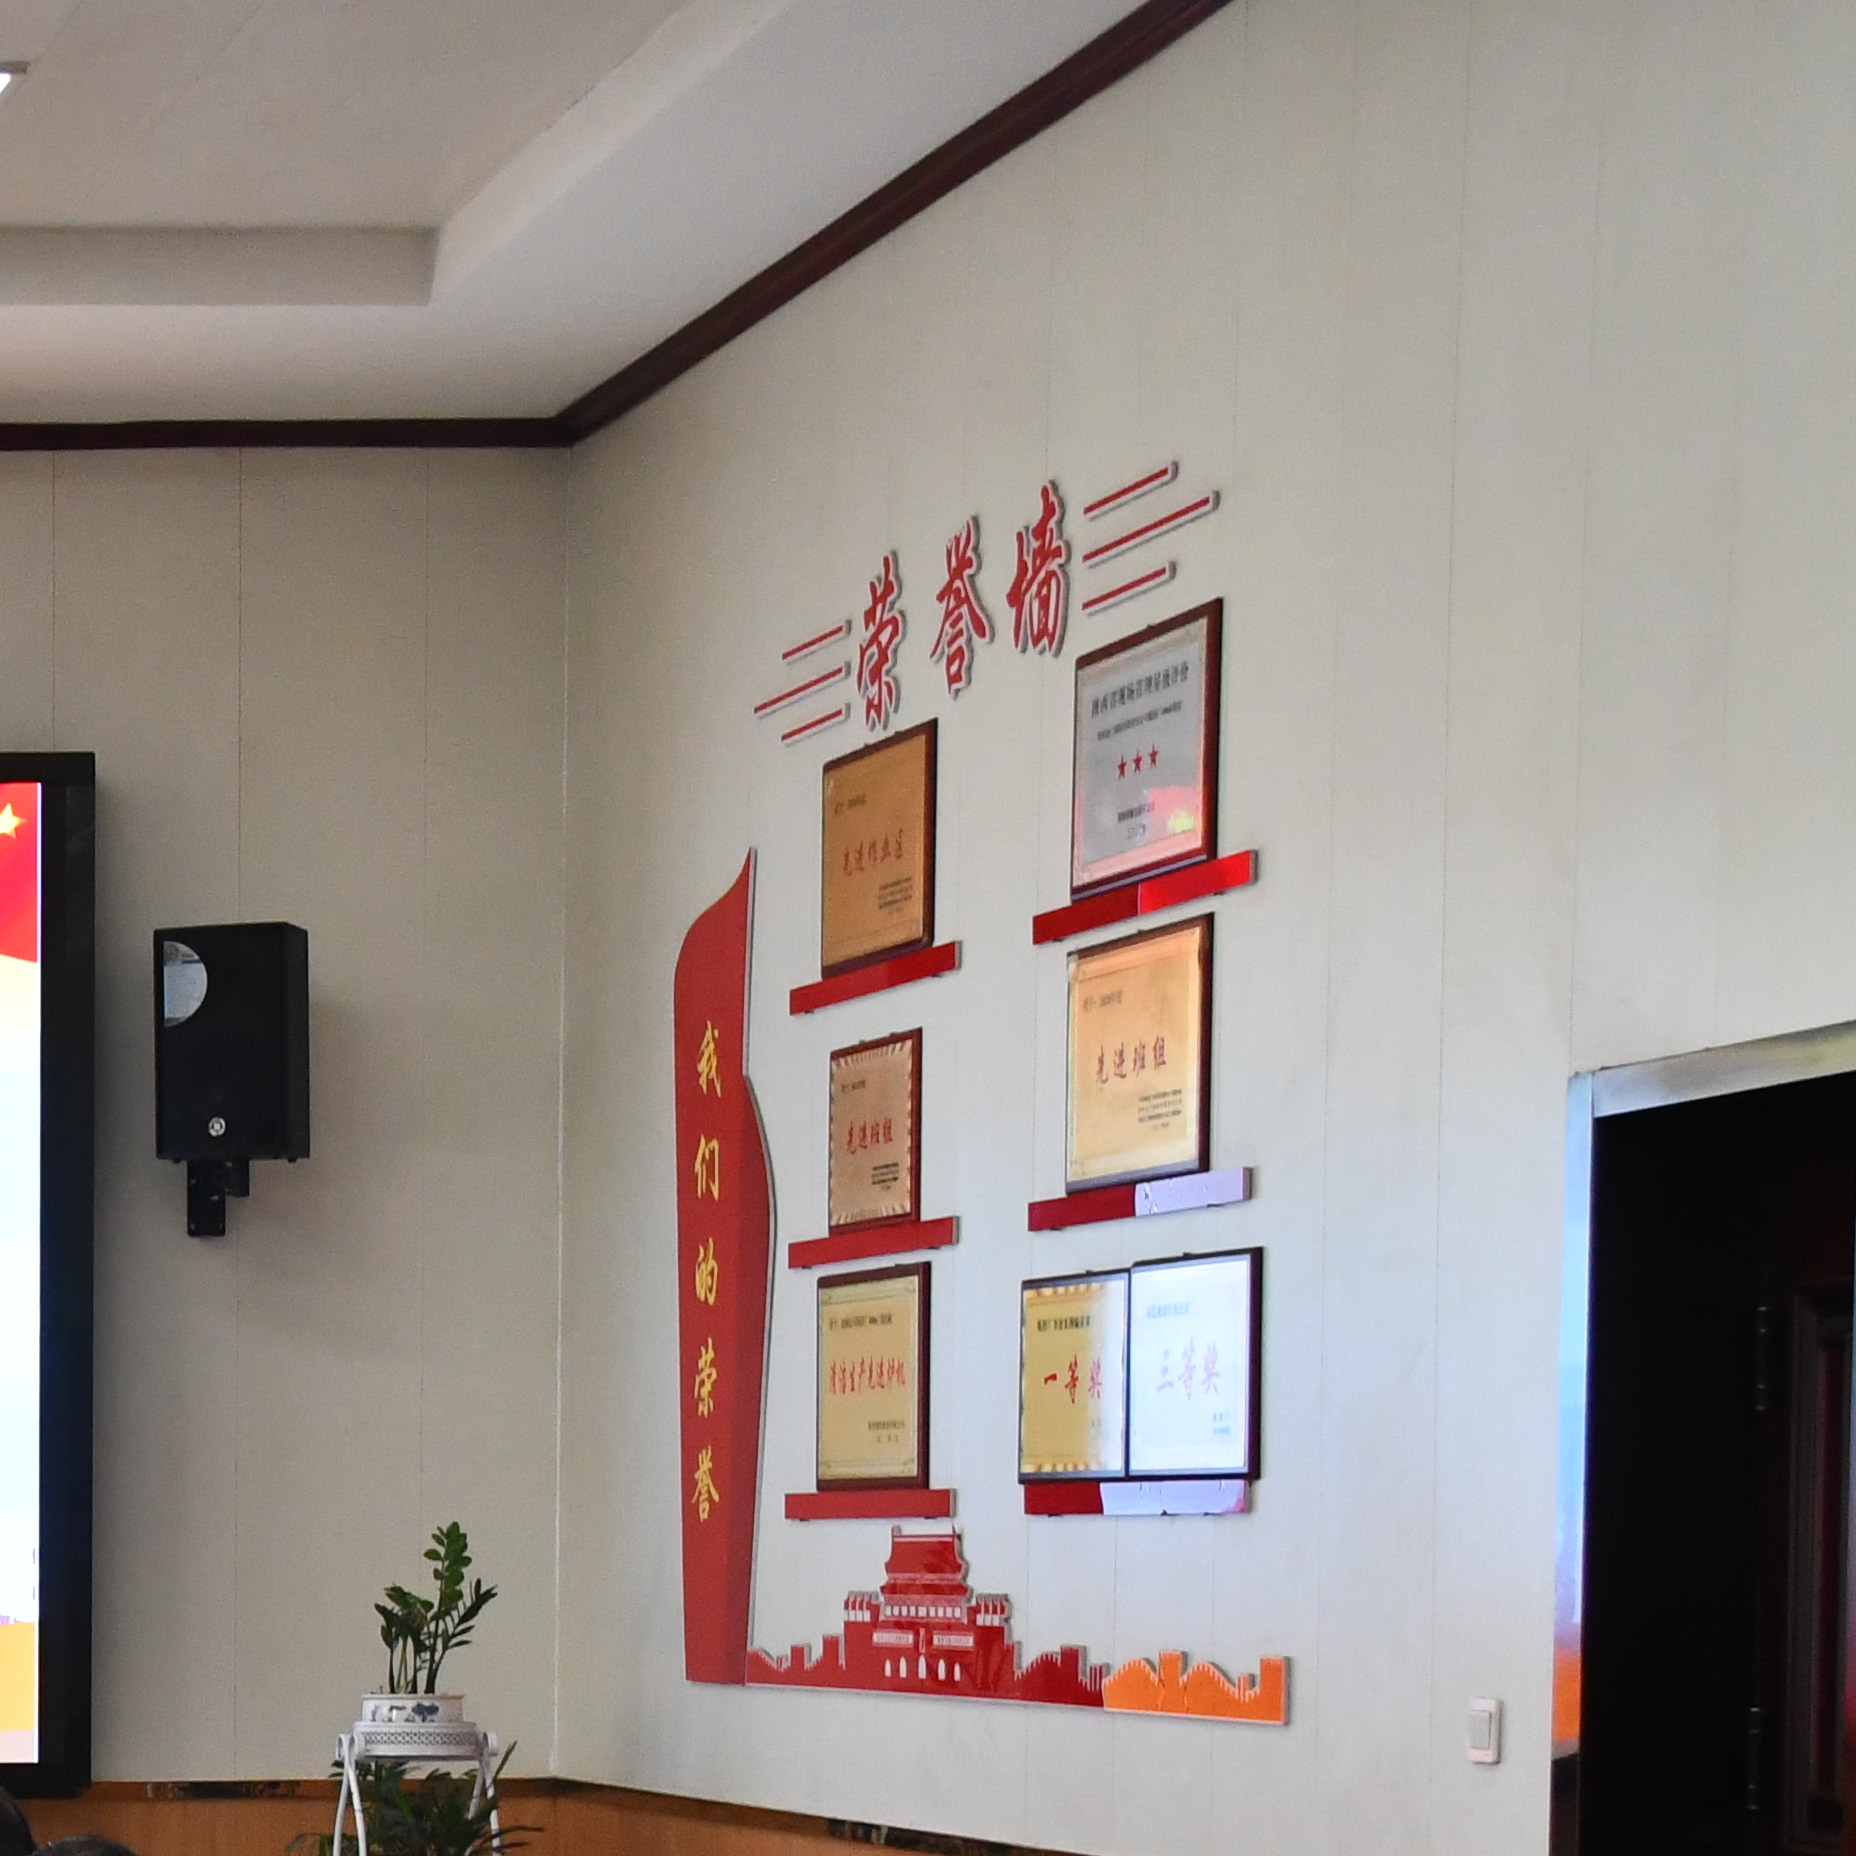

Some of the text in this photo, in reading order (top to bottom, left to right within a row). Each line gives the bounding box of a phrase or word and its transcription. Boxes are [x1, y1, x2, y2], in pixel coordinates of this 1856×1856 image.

[856, 484, 1064, 727] 荣誉墙
[1096, 1036, 1166, 1084] 先进班组
[847, 1117, 893, 1154] 先进班组
[691, 1020, 722, 1523] 我们的荣誉
[1044, 1354, 1102, 1404] 一等奖
[1156, 1337, 1221, 1400] 三等奖
